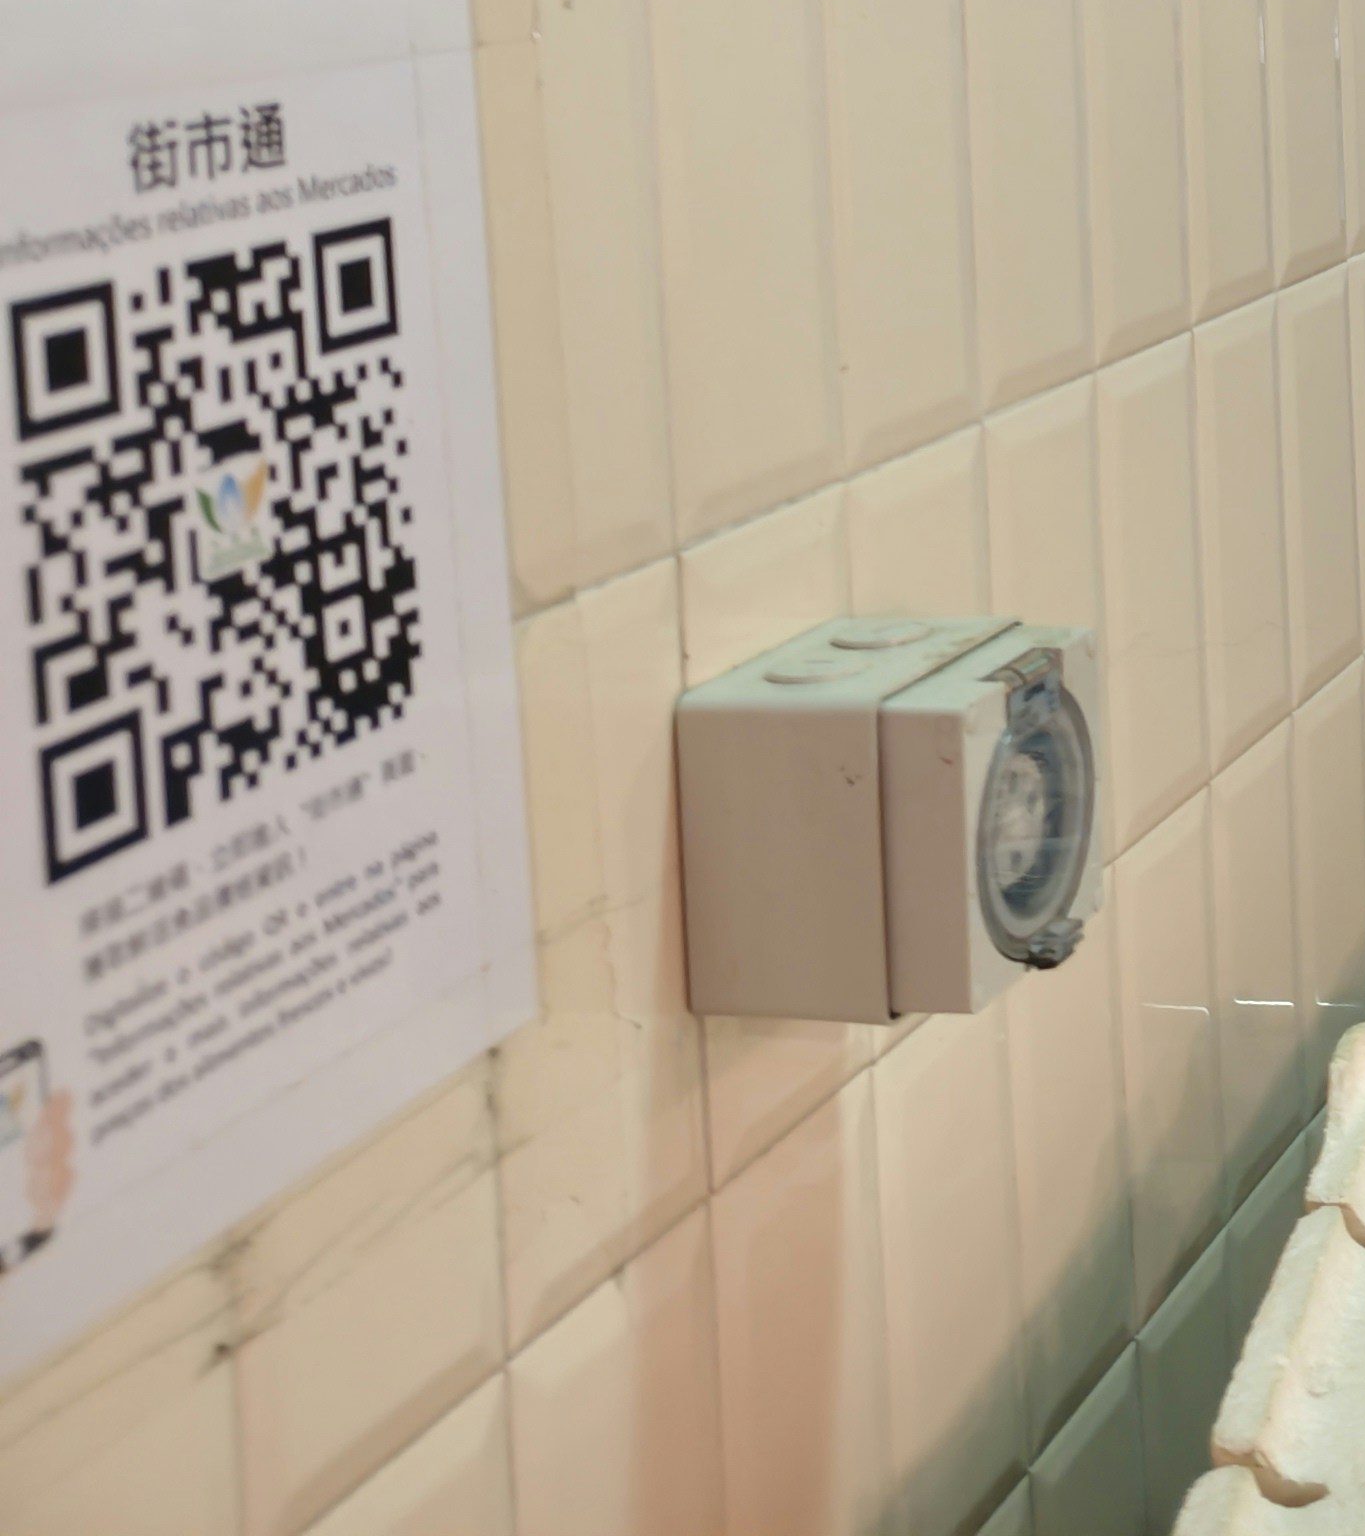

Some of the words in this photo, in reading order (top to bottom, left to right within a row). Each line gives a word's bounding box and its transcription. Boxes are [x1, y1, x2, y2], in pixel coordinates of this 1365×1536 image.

[127, 101, 288, 193] 街市通
[0, 205, 154, 263] nformações
[156, 191, 252, 233] relativas
[255, 183, 294, 214] aos
[298, 161, 400, 205] Mercados
